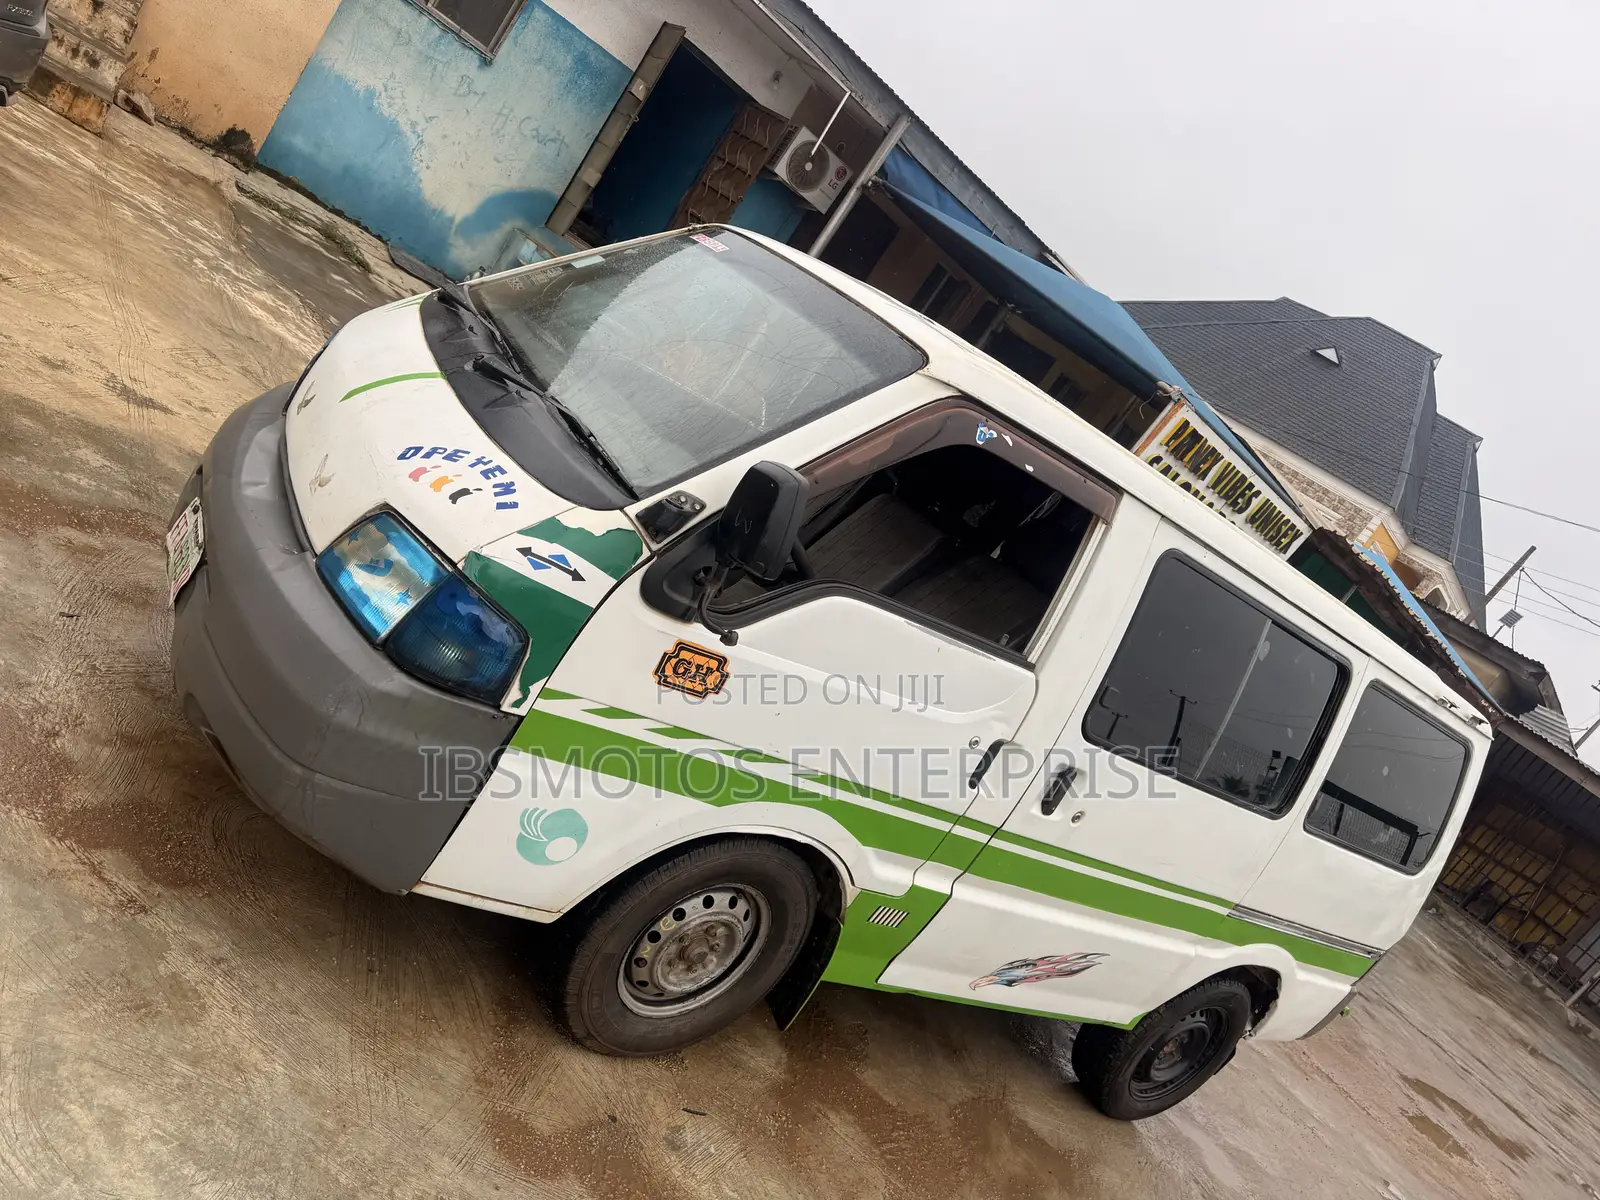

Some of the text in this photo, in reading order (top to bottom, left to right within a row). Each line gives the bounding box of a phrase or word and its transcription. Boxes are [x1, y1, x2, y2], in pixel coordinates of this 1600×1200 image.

[827, 178, 839, 191] LG
[396, 445, 519, 511] OPEYEMI
[1207, 459, 1262, 514] VIBES
[1245, 496, 1304, 555] UNISEX
